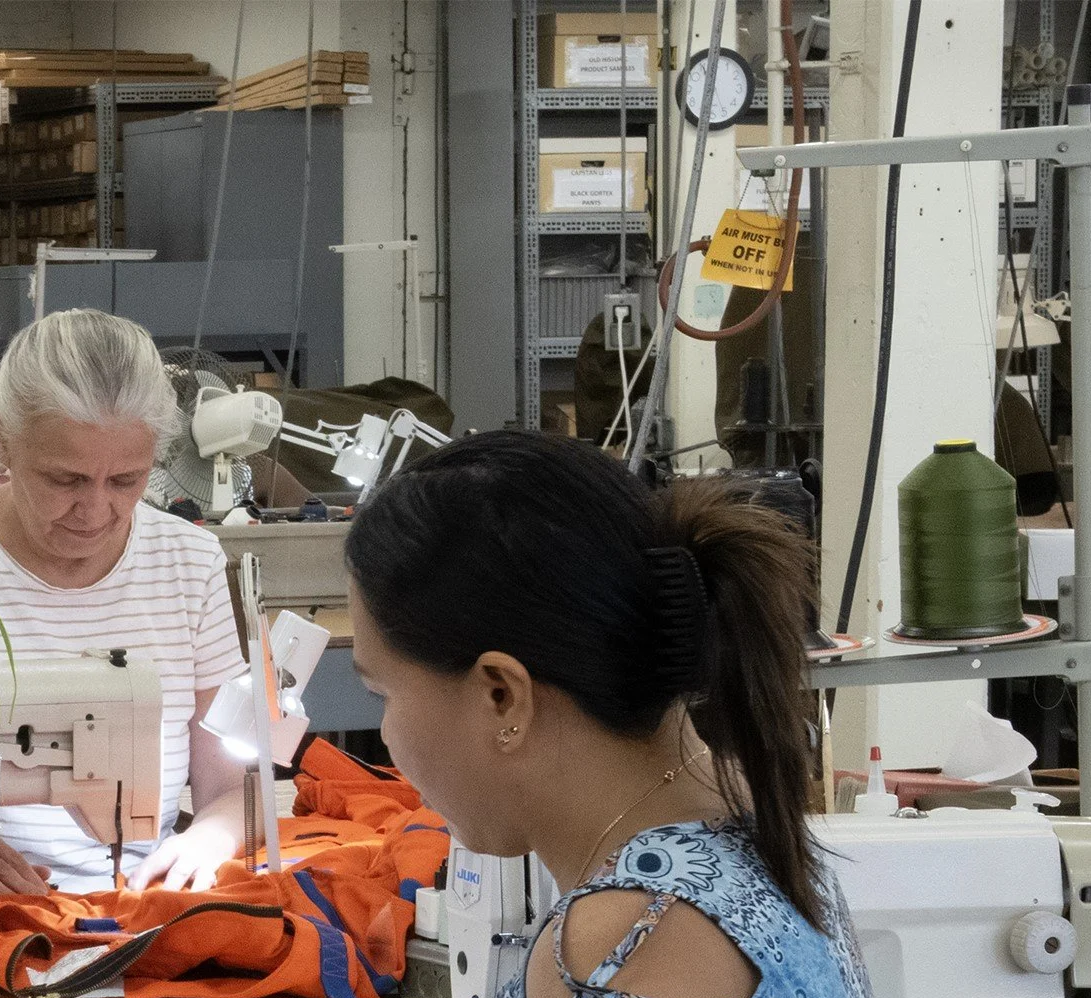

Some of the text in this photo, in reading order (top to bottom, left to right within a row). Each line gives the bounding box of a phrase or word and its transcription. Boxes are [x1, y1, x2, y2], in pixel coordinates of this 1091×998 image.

[721, 227, 740, 239] AIR
[741, 231, 771, 245] MUST
[732, 245, 766, 263] OFF
[710, 258, 734, 270] WHEN
[735, 265, 754, 274] NOT
[755, 268, 765, 276] IN
[457, 868, 480, 885] JUKI
